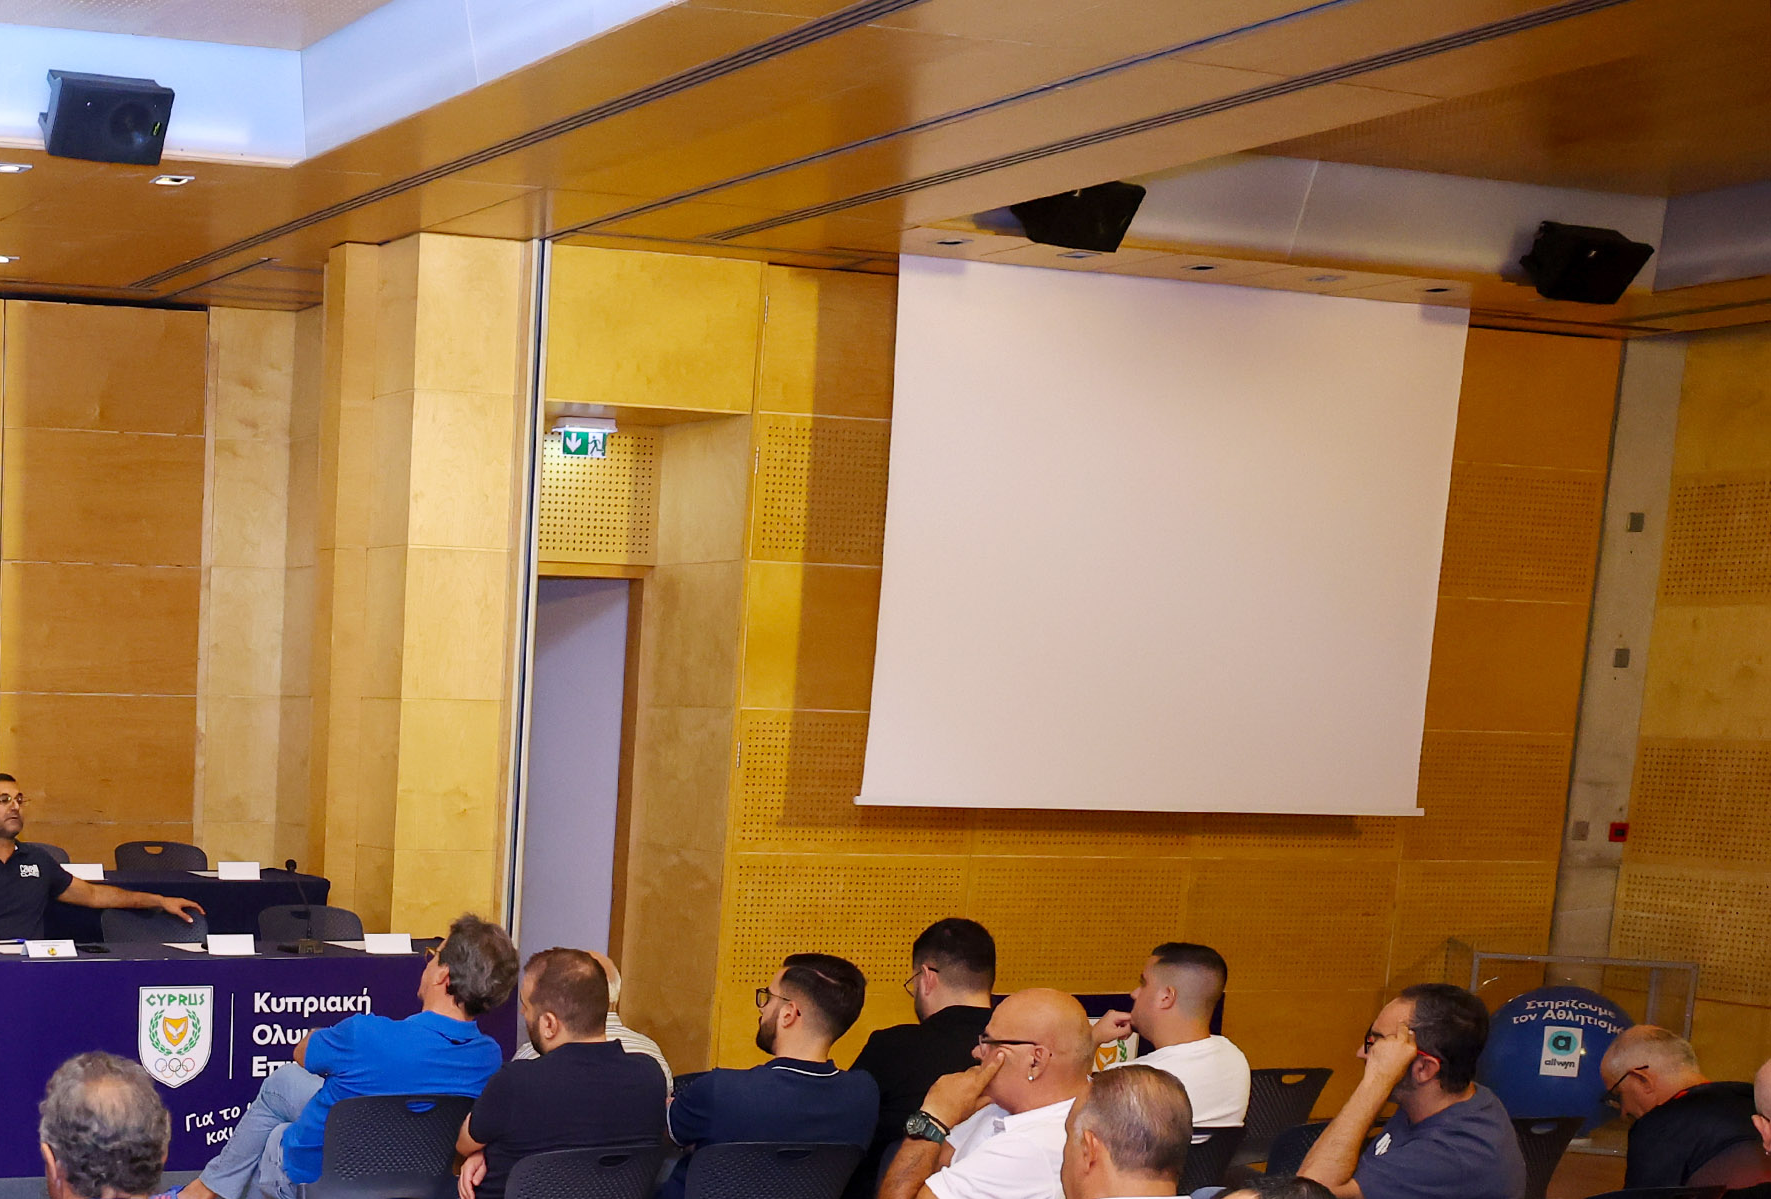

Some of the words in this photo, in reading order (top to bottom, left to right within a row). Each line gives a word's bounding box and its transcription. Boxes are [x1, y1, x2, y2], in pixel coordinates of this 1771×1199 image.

[146, 993, 205, 1006] CYPRUS
[253, 988, 371, 1017] Κυπριακή
[1526, 1000, 1616, 1018] Στηρίζουμε
[1513, 1013, 1537, 1024] τον
[1544, 1058, 1575, 1069] allwyn
[185, 1112, 213, 1132] Για
[219, 1107, 240, 1121] το
[206, 1126, 233, 1145] και
